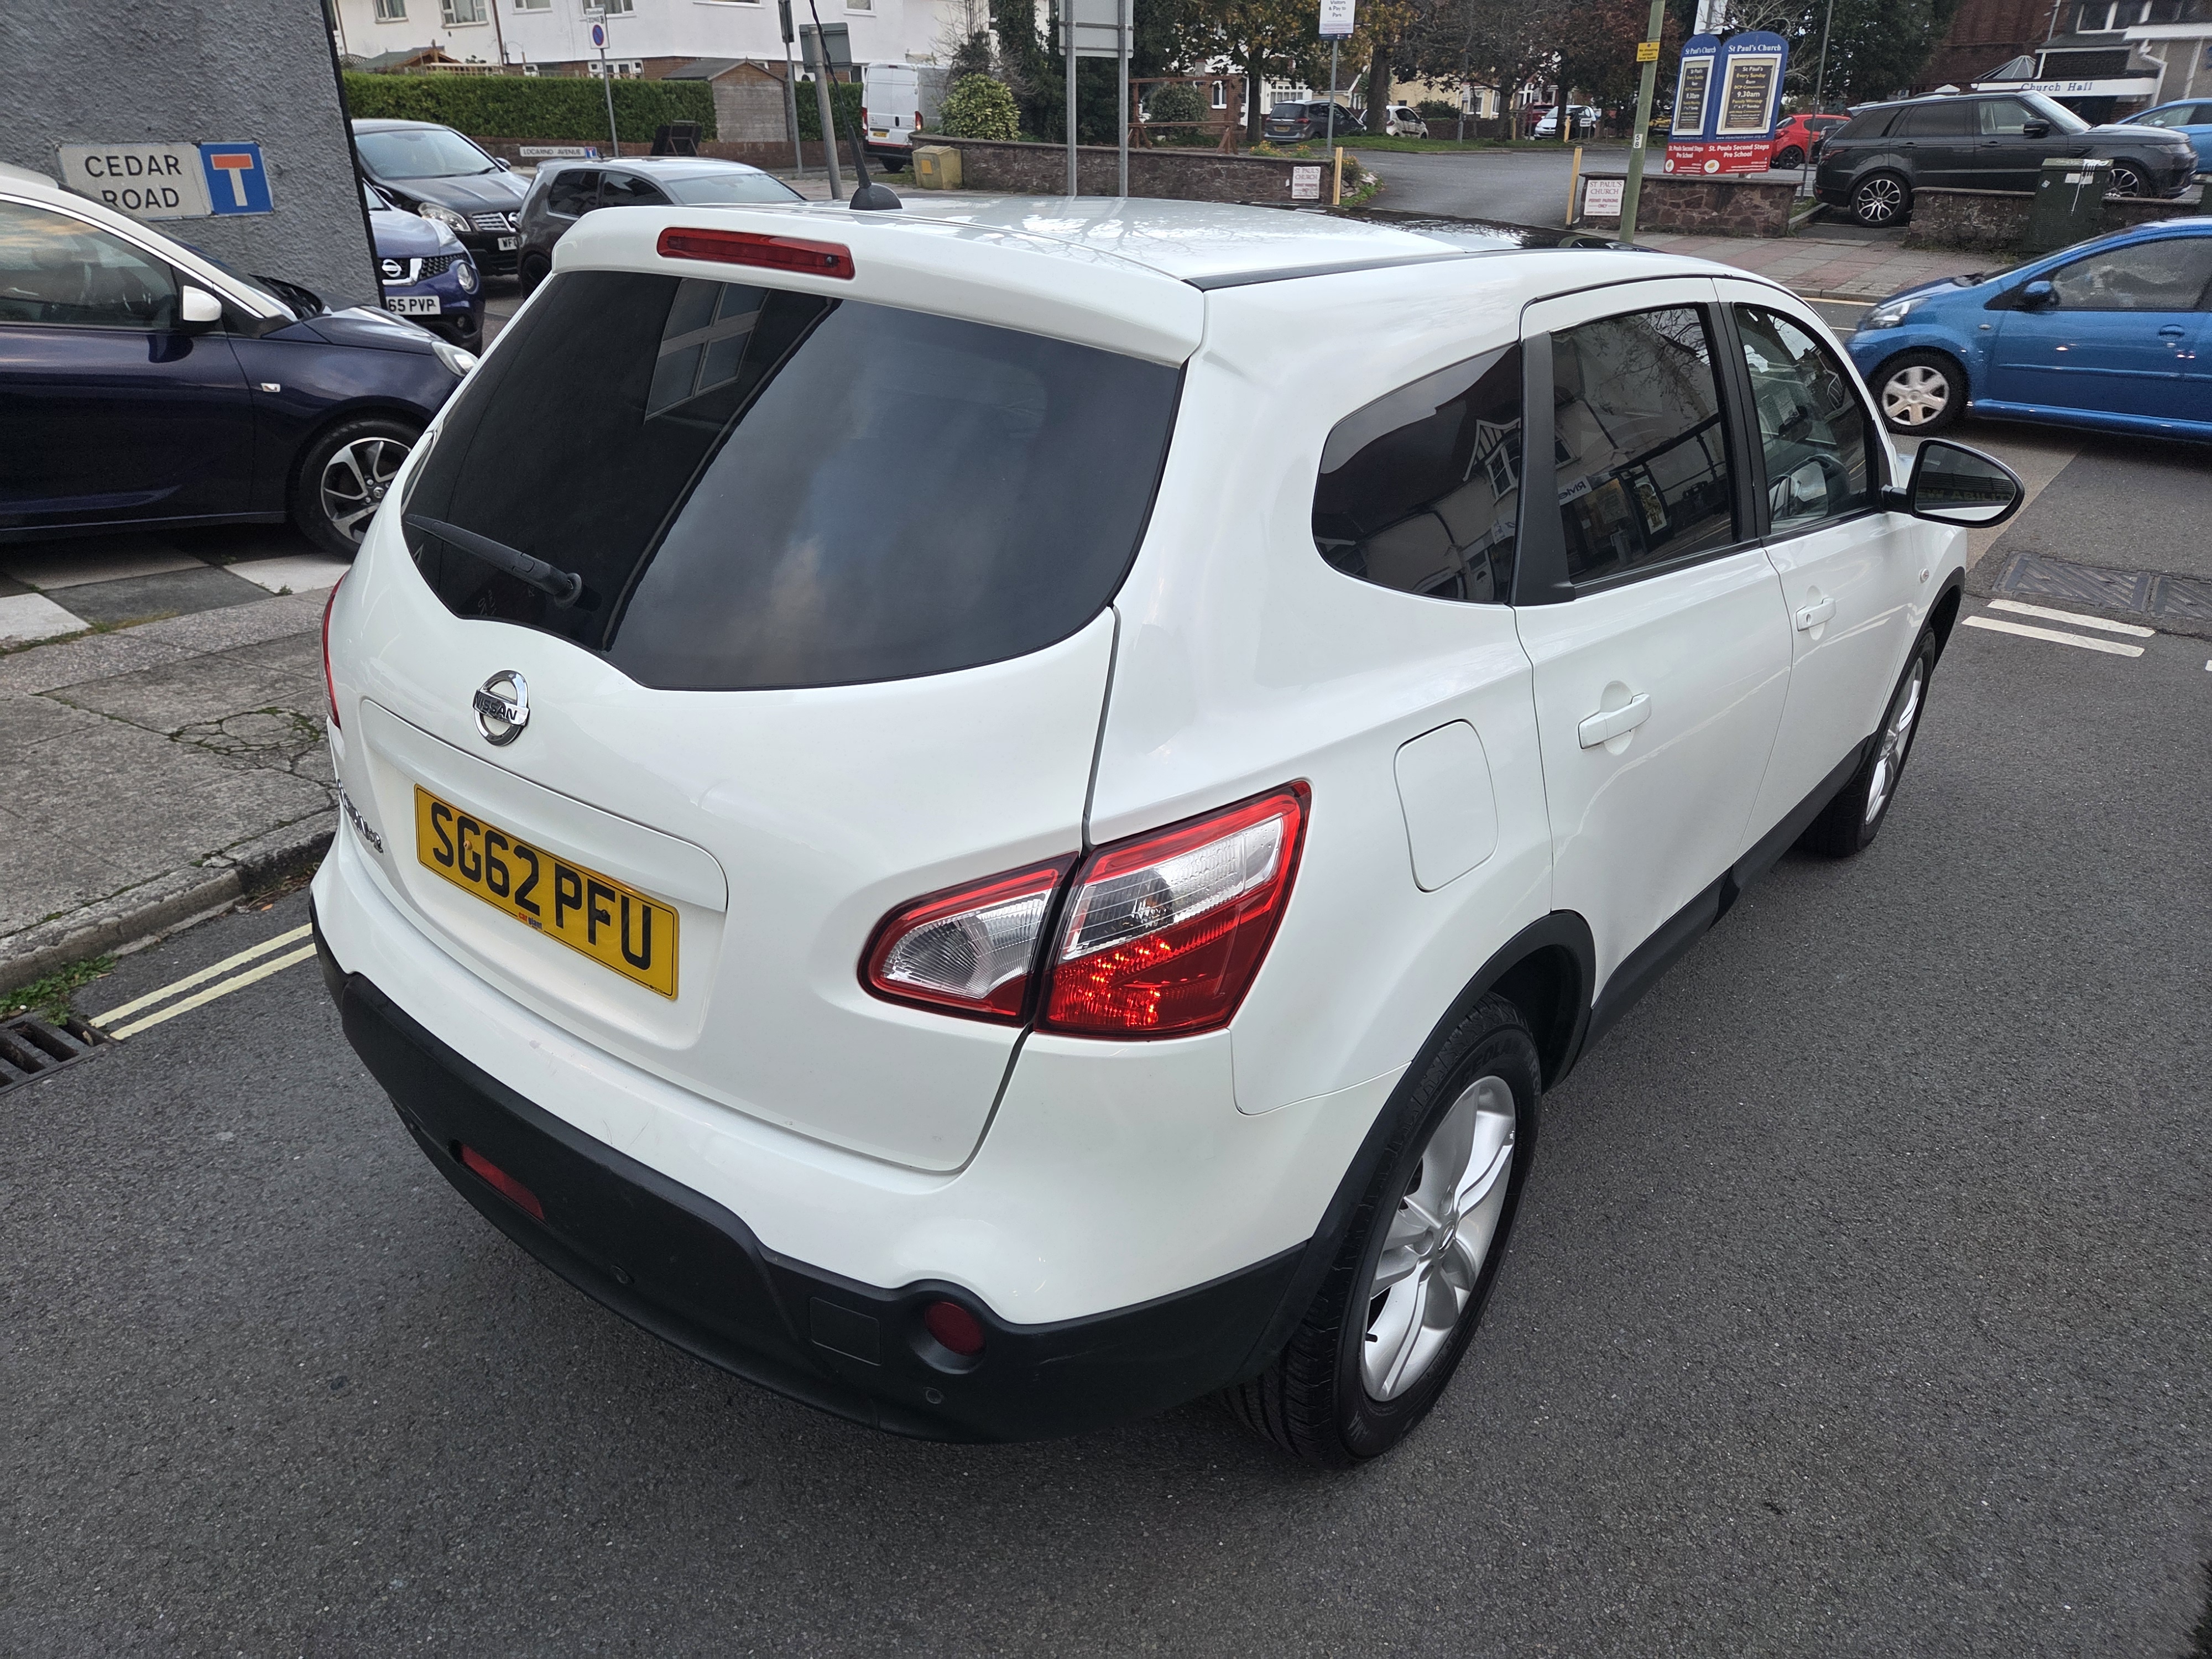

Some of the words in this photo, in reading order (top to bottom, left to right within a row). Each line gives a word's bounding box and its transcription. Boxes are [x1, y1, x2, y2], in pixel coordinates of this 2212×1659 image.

[2021, 83, 2060, 91] Church
[2067, 82, 2093, 91] Hall
[85, 155, 182, 178] CEDAR
[101, 187, 180, 210] ROAD
[388, 299, 406, 312] 65
[409, 299, 435, 312] PVP
[476, 691, 518, 721] NISSAN
[430, 801, 541, 917] SG62
[555, 862, 651, 971] PFU
